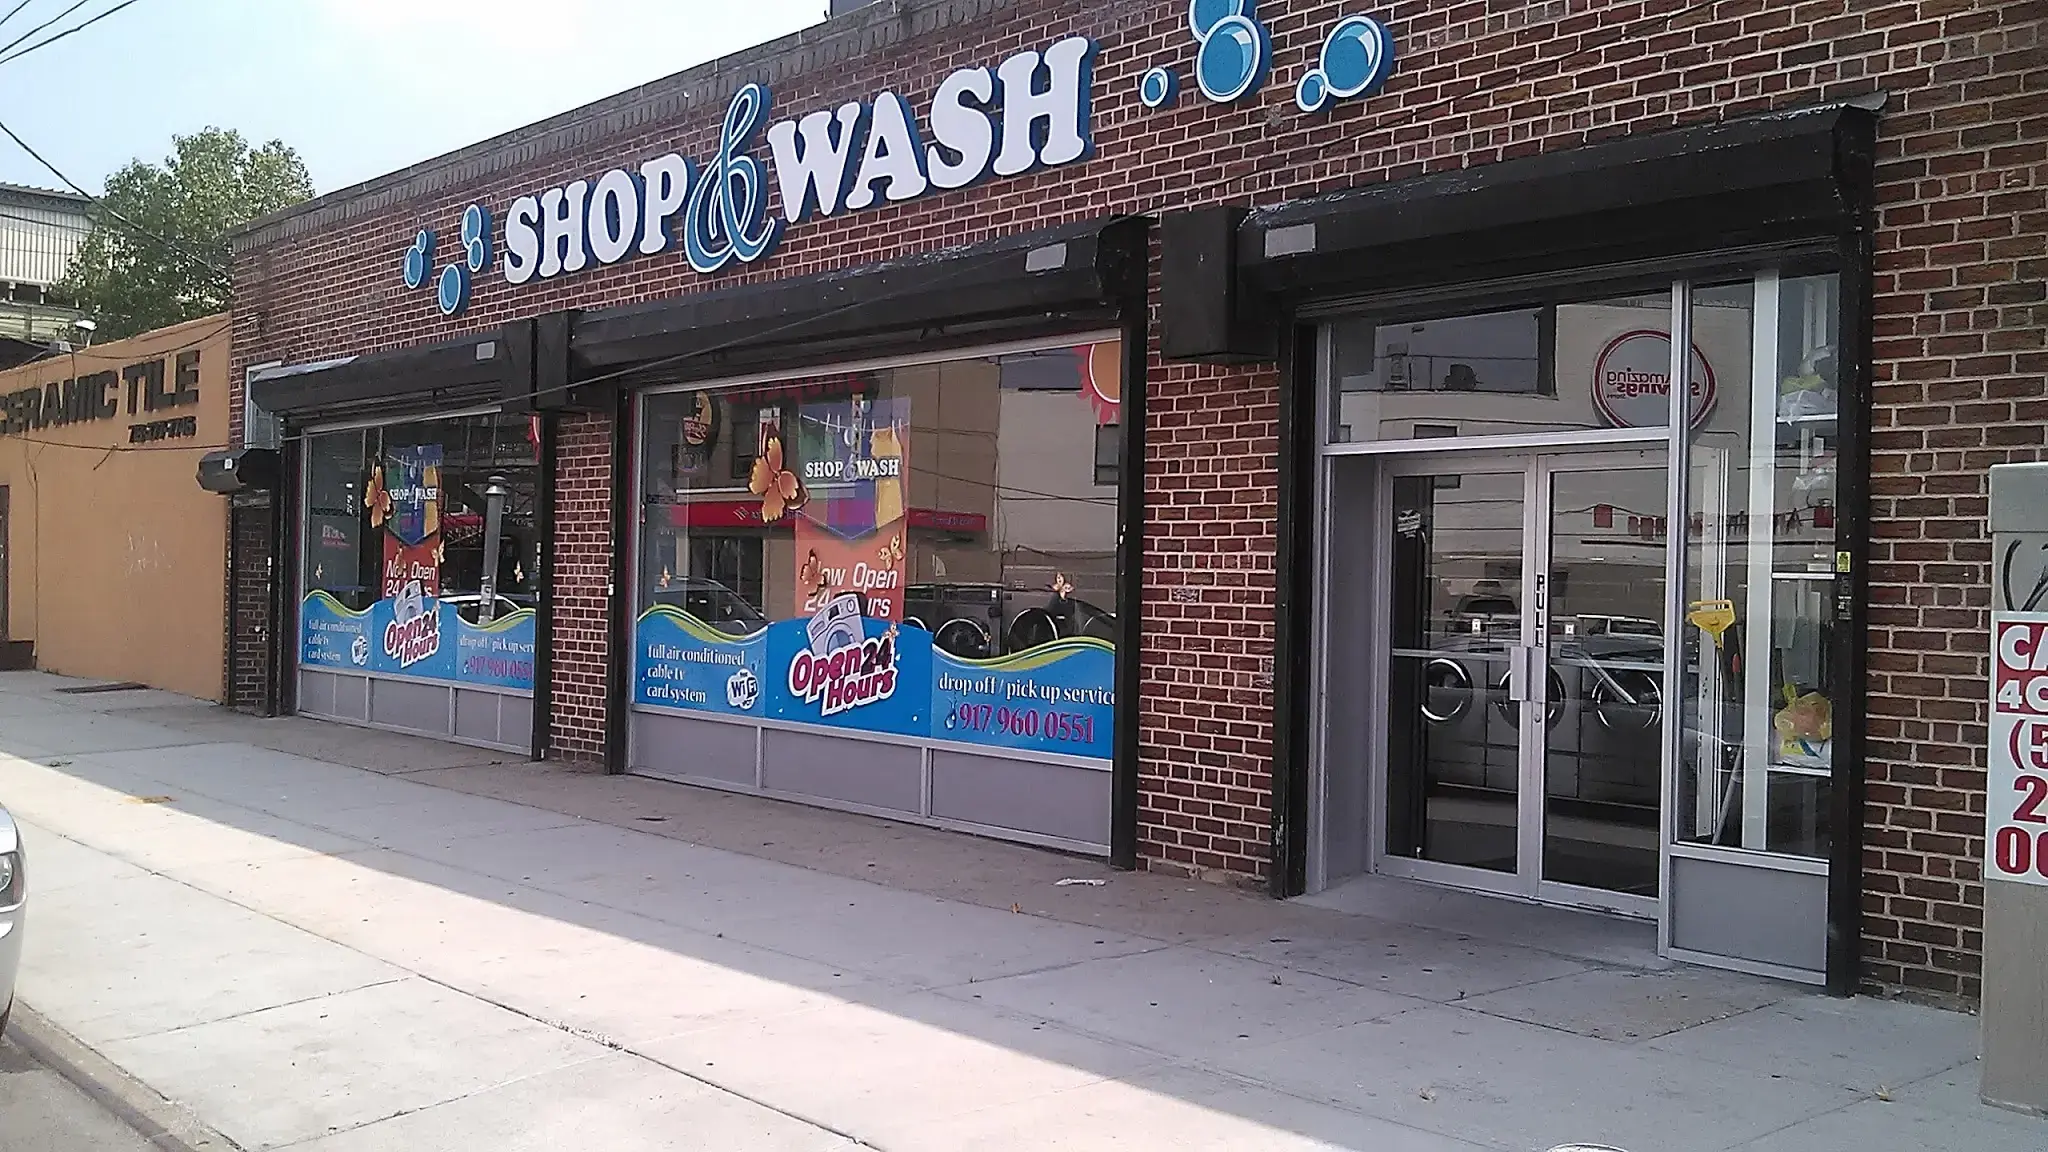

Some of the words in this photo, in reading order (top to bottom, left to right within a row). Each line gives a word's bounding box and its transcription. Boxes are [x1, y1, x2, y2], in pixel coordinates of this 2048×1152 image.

[504, 153, 692, 284] SHOP
[685, 82, 780, 272] &
[767, 36, 1094, 223] WASH
[122, 350, 200, 416] TILE
[805, 461, 843, 478] SHOP
[857, 459, 899, 477] WASH
[390, 488, 409, 501] SHOP
[411, 560, 436, 583] Open
[853, 562, 898, 593] Open
[385, 579, 400, 598] 24
[1535, 574, 1545, 648] PULL
[386, 617, 421, 656] Open
[421, 610, 438, 639] 24
[403, 633, 439, 664] Hours
[648, 643, 666, 659] full
[666, 645, 681, 661] air
[681, 647, 745, 667] conditioned
[792, 646, 861, 697] Open
[860, 637, 893, 678] 24
[647, 663, 674, 680] cable
[674, 667, 685, 681] tv
[646, 683, 669, 699] card
[670, 687, 706, 704] system
[826, 669, 895, 710] Hours
[939, 672, 972, 696] drop
[975, 676, 997, 694] off
[1006, 677, 1038, 700] pick
[1040, 684, 1061, 704] up
[959, 703, 993, 733] 917
[997, 706, 1039, 737] 960
[1044, 711, 1094, 743] 0551
